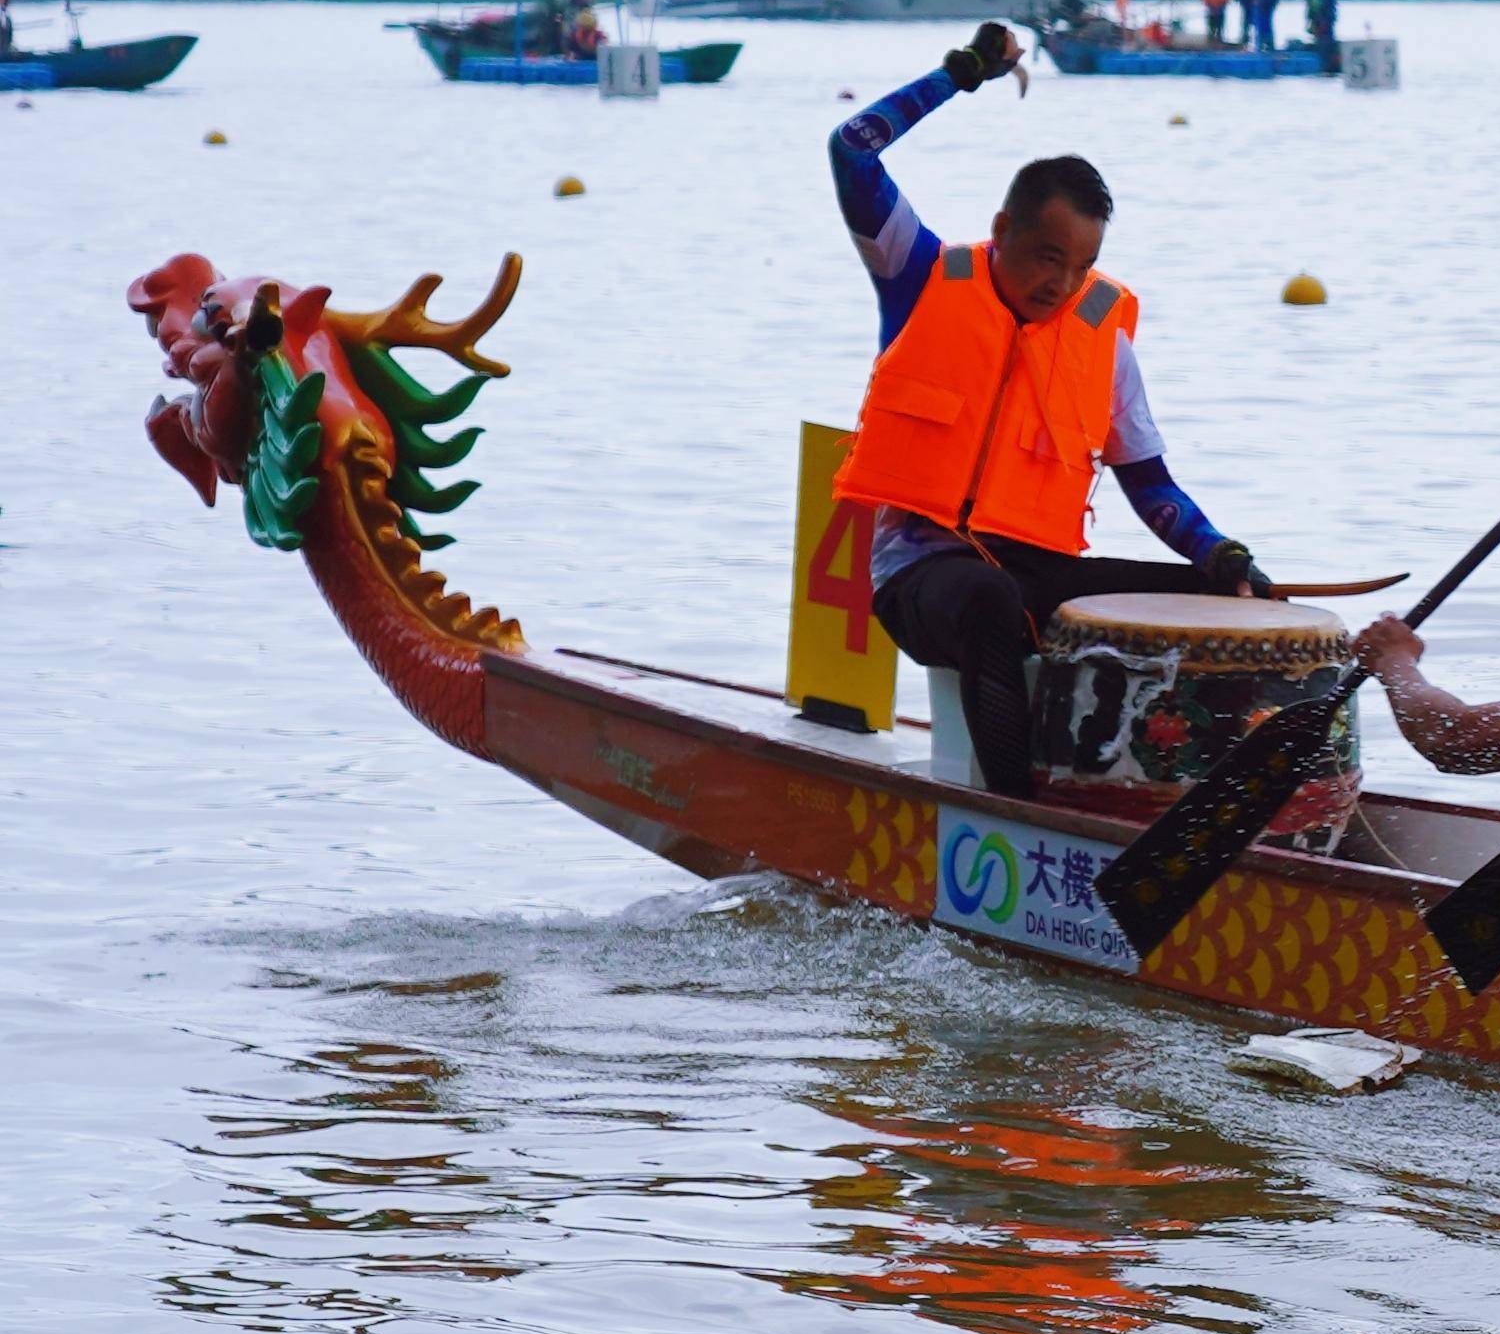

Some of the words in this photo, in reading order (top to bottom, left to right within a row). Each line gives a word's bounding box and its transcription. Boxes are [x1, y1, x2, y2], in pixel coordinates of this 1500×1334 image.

[807, 498, 877, 655] 4
[1026, 840, 1113, 913] 大横
[1026, 911, 1047, 938] DA
[1052, 919, 1096, 949] HENG
